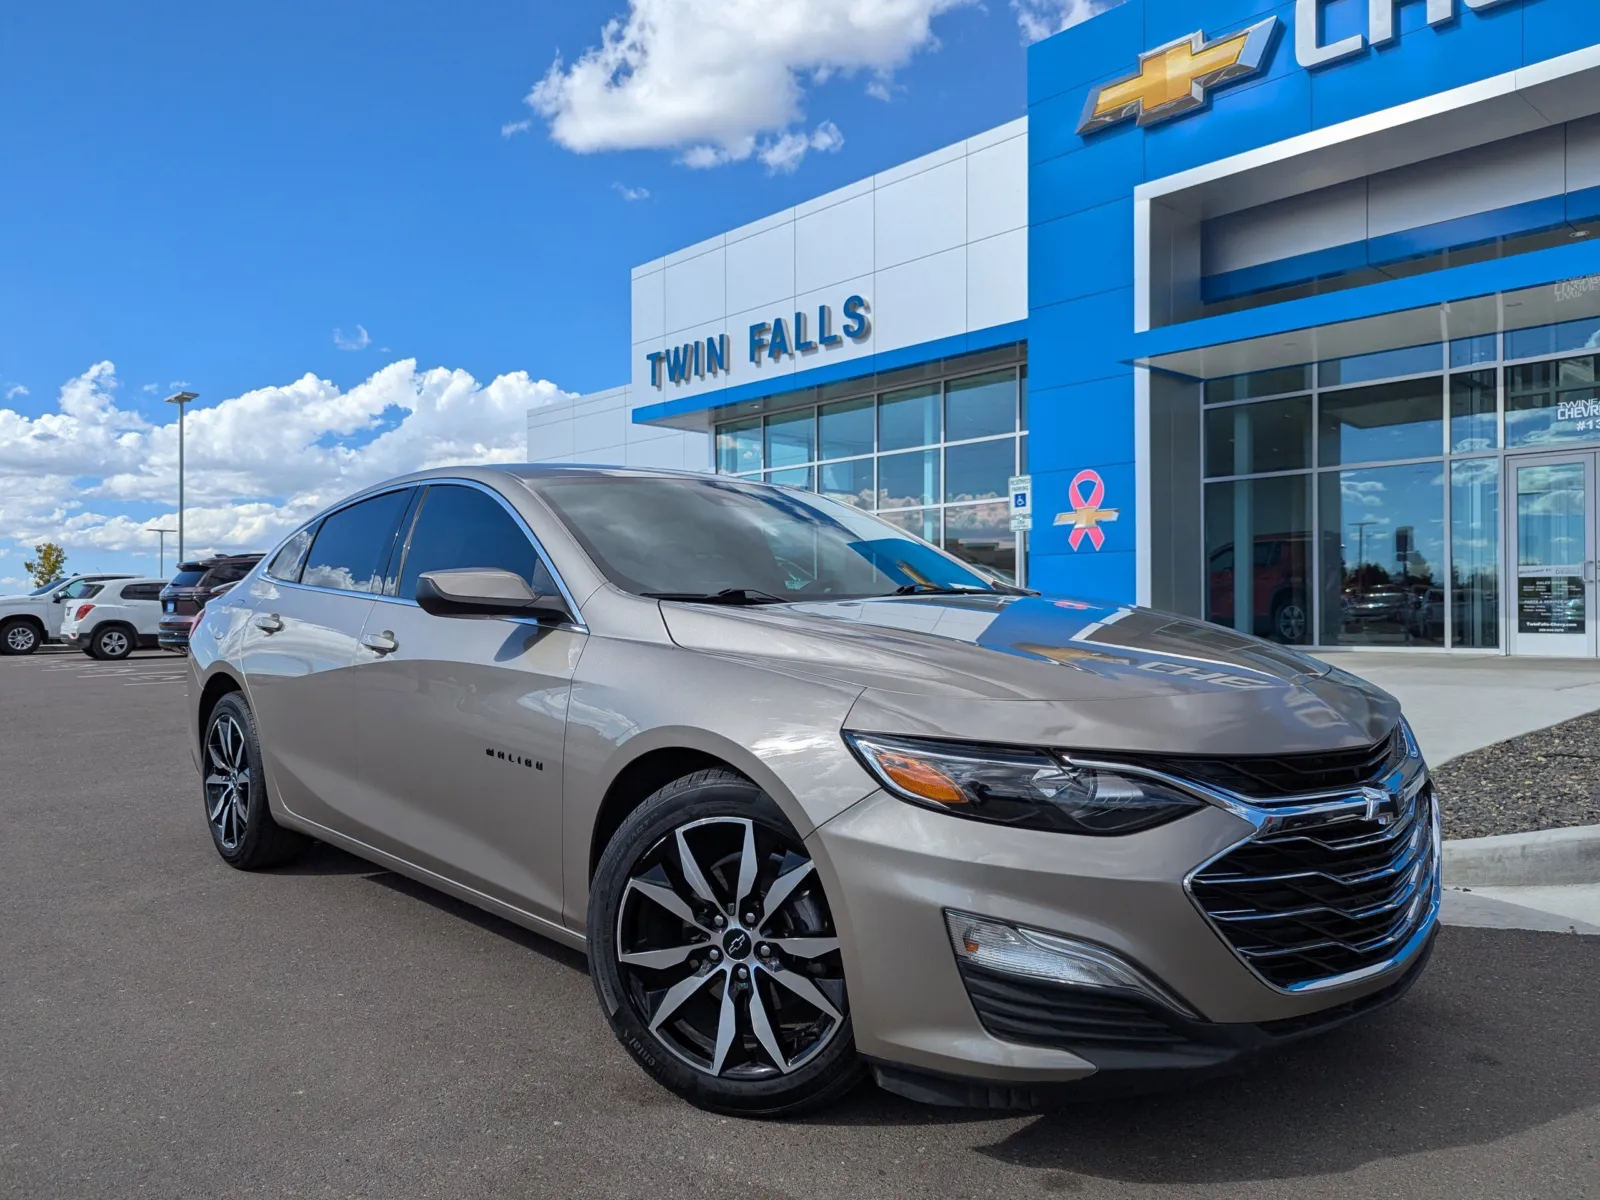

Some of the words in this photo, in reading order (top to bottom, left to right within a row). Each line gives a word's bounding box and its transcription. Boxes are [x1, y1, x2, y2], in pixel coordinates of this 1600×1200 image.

[647, 334, 728, 388] TWIN
[749, 295, 870, 364] FALLS
[1557, 405, 1600, 420] CHEVR
[485, 748, 543, 771] MALIBU
